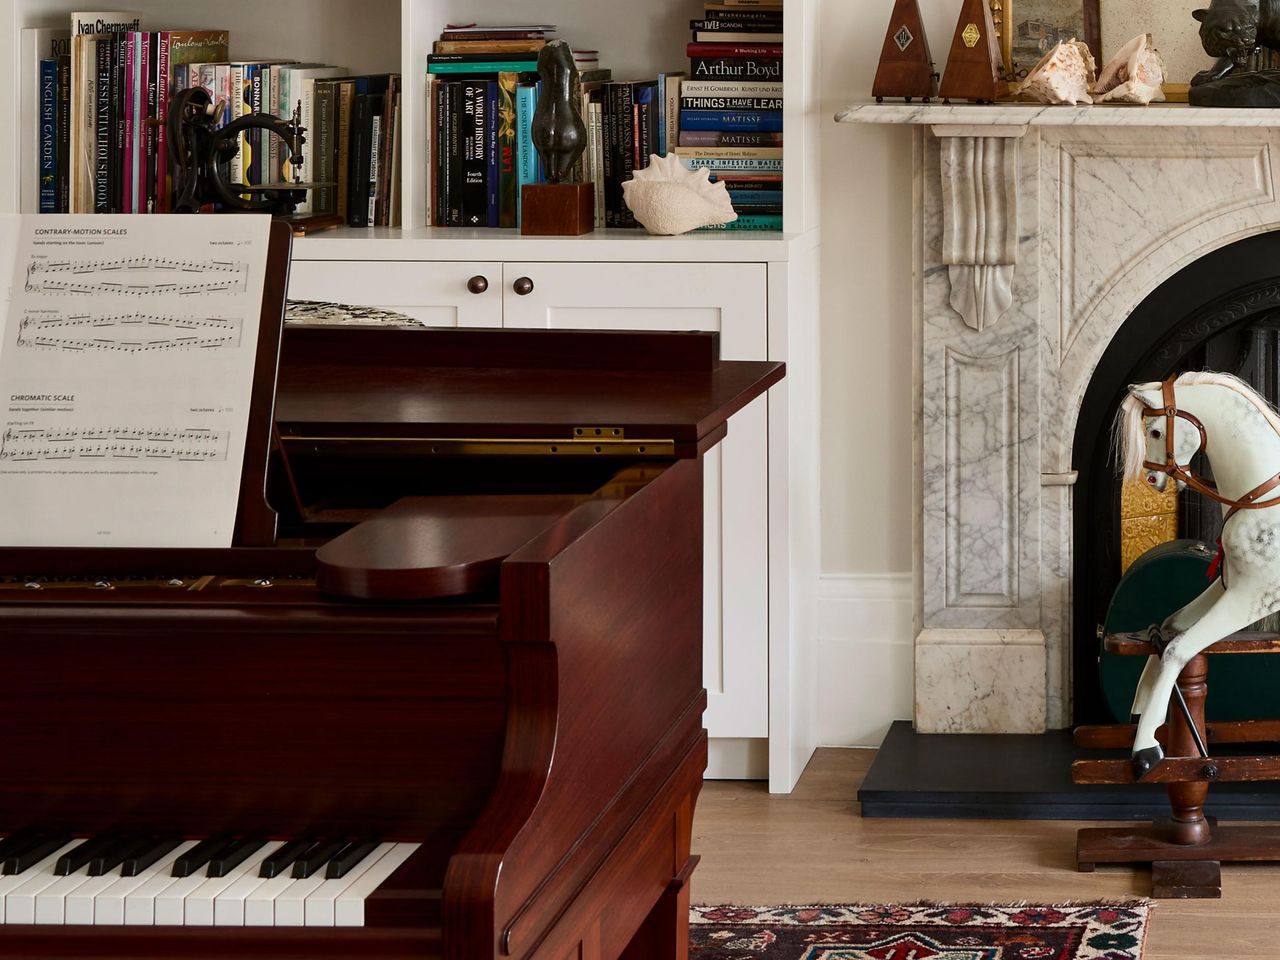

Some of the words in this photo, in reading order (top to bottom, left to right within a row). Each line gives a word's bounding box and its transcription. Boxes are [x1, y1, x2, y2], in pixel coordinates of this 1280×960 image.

[77, 19, 96, 35] Ivan
[159, 39, 169, 102] Toulouse-Lautrec
[695, 60, 744, 75] Arthur
[746, 60, 780, 79] Boyd
[44, 75, 53, 120] ENGLISH
[148, 82, 156, 106] Monet
[465, 87, 474, 98] OF
[686, 98, 725, 108] THINGS
[726, 98, 731, 106] I
[732, 98, 753, 106] HAVE
[98, 77, 109, 138] ESSENTIAL
[465, 99, 474, 115] ART
[475, 95, 484, 126] WORLD
[43, 124, 53, 169] GARDEN
[475, 127, 484, 161] HISTORY
[502, 147, 513, 172] LAM
[34, 228, 102, 236] CONTRARY-MOTION
[10, 394, 52, 402] CHROMATIC
[53, 394, 75, 402] SCALE
